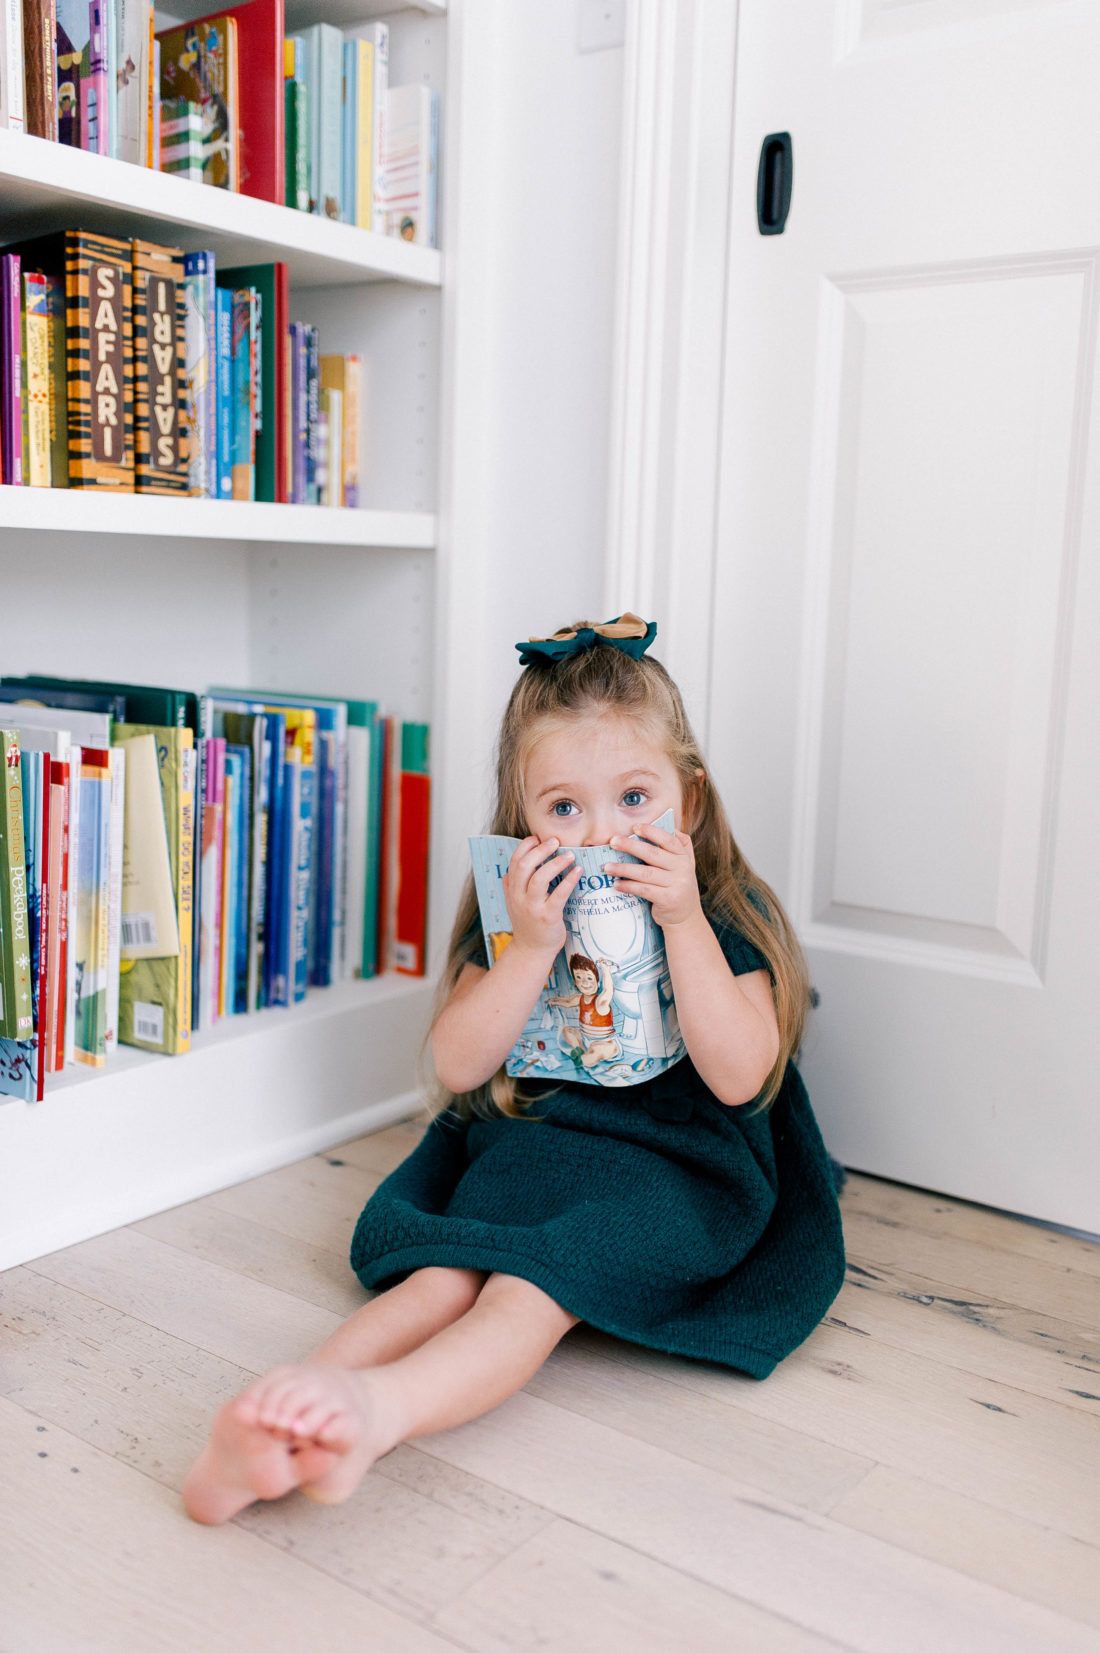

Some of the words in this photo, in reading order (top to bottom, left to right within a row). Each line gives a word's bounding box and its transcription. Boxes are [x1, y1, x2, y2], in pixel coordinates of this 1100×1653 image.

[44, 18, 52, 74] SOMETHING'S
[94, 266, 119, 458] SAFARI
[151, 281, 176, 466] SAFARI
[8, 785, 22, 862] Christmas
[182, 804, 191, 836] WHAT
[182, 841, 191, 857] DO
[182, 861, 191, 881] YOU
[11, 866, 26, 940] peekaboo!
[579, 907, 610, 916] SHEILA
[601, 892, 634, 904] MUNSC
